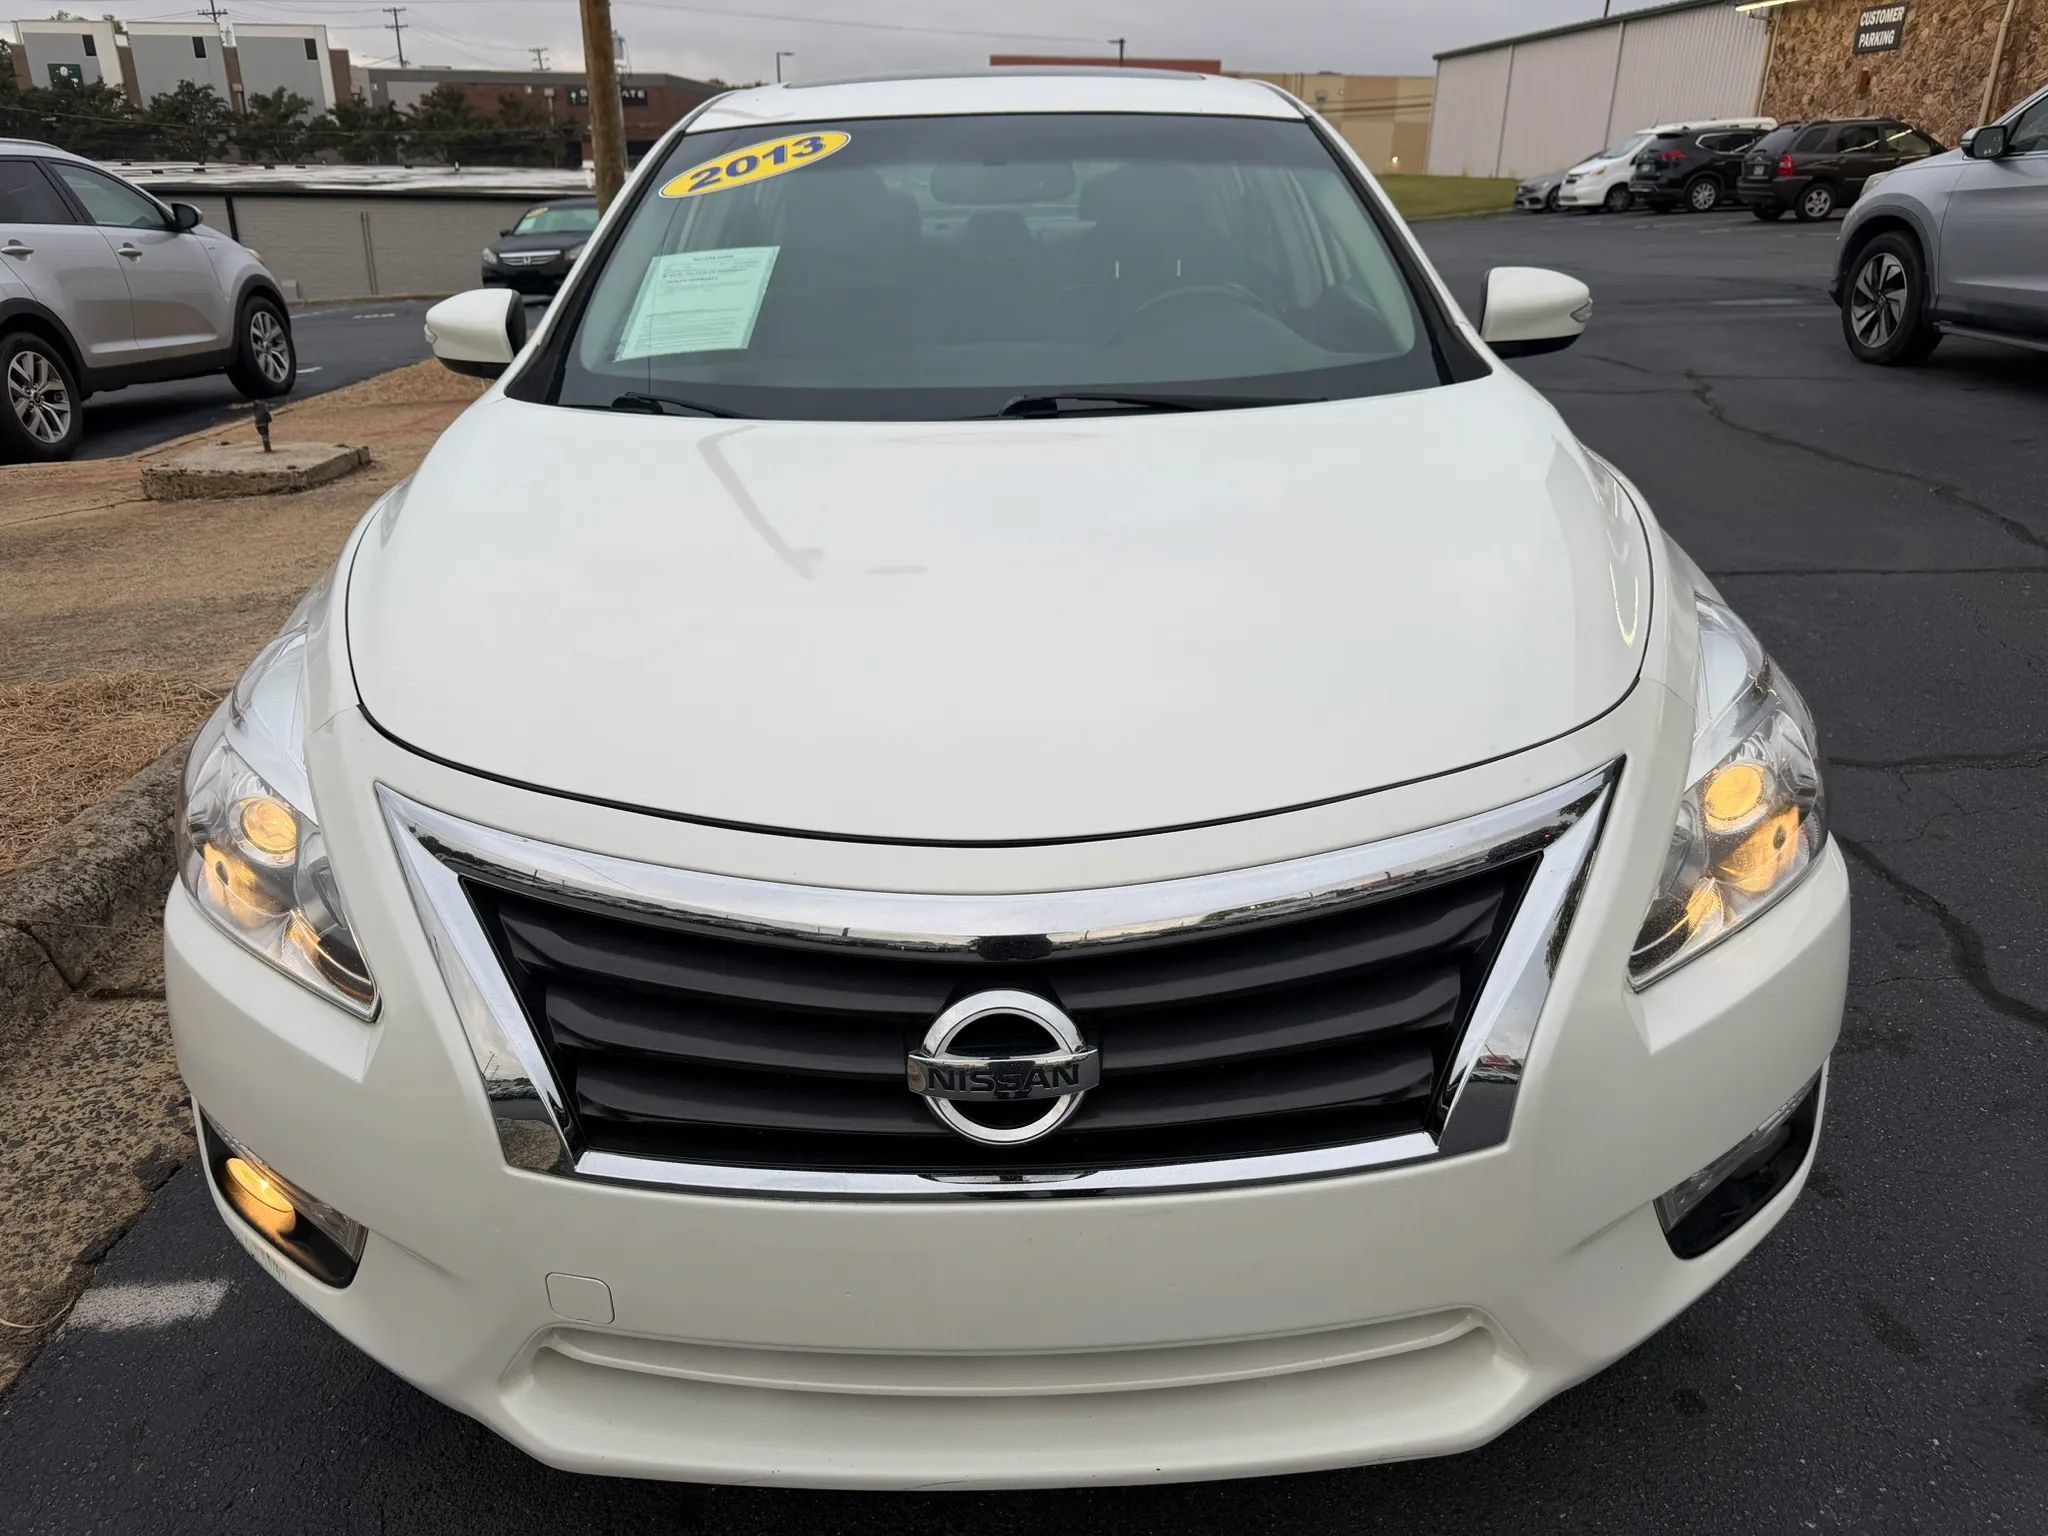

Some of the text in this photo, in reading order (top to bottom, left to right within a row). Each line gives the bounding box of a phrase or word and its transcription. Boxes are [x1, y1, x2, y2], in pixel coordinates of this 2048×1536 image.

[1860, 6, 1905, 26] CUSTOMER
[1858, 30, 1895, 48] PARKING
[687, 135, 826, 193] 2013
[928, 1063, 1080, 1093] NISSAN
